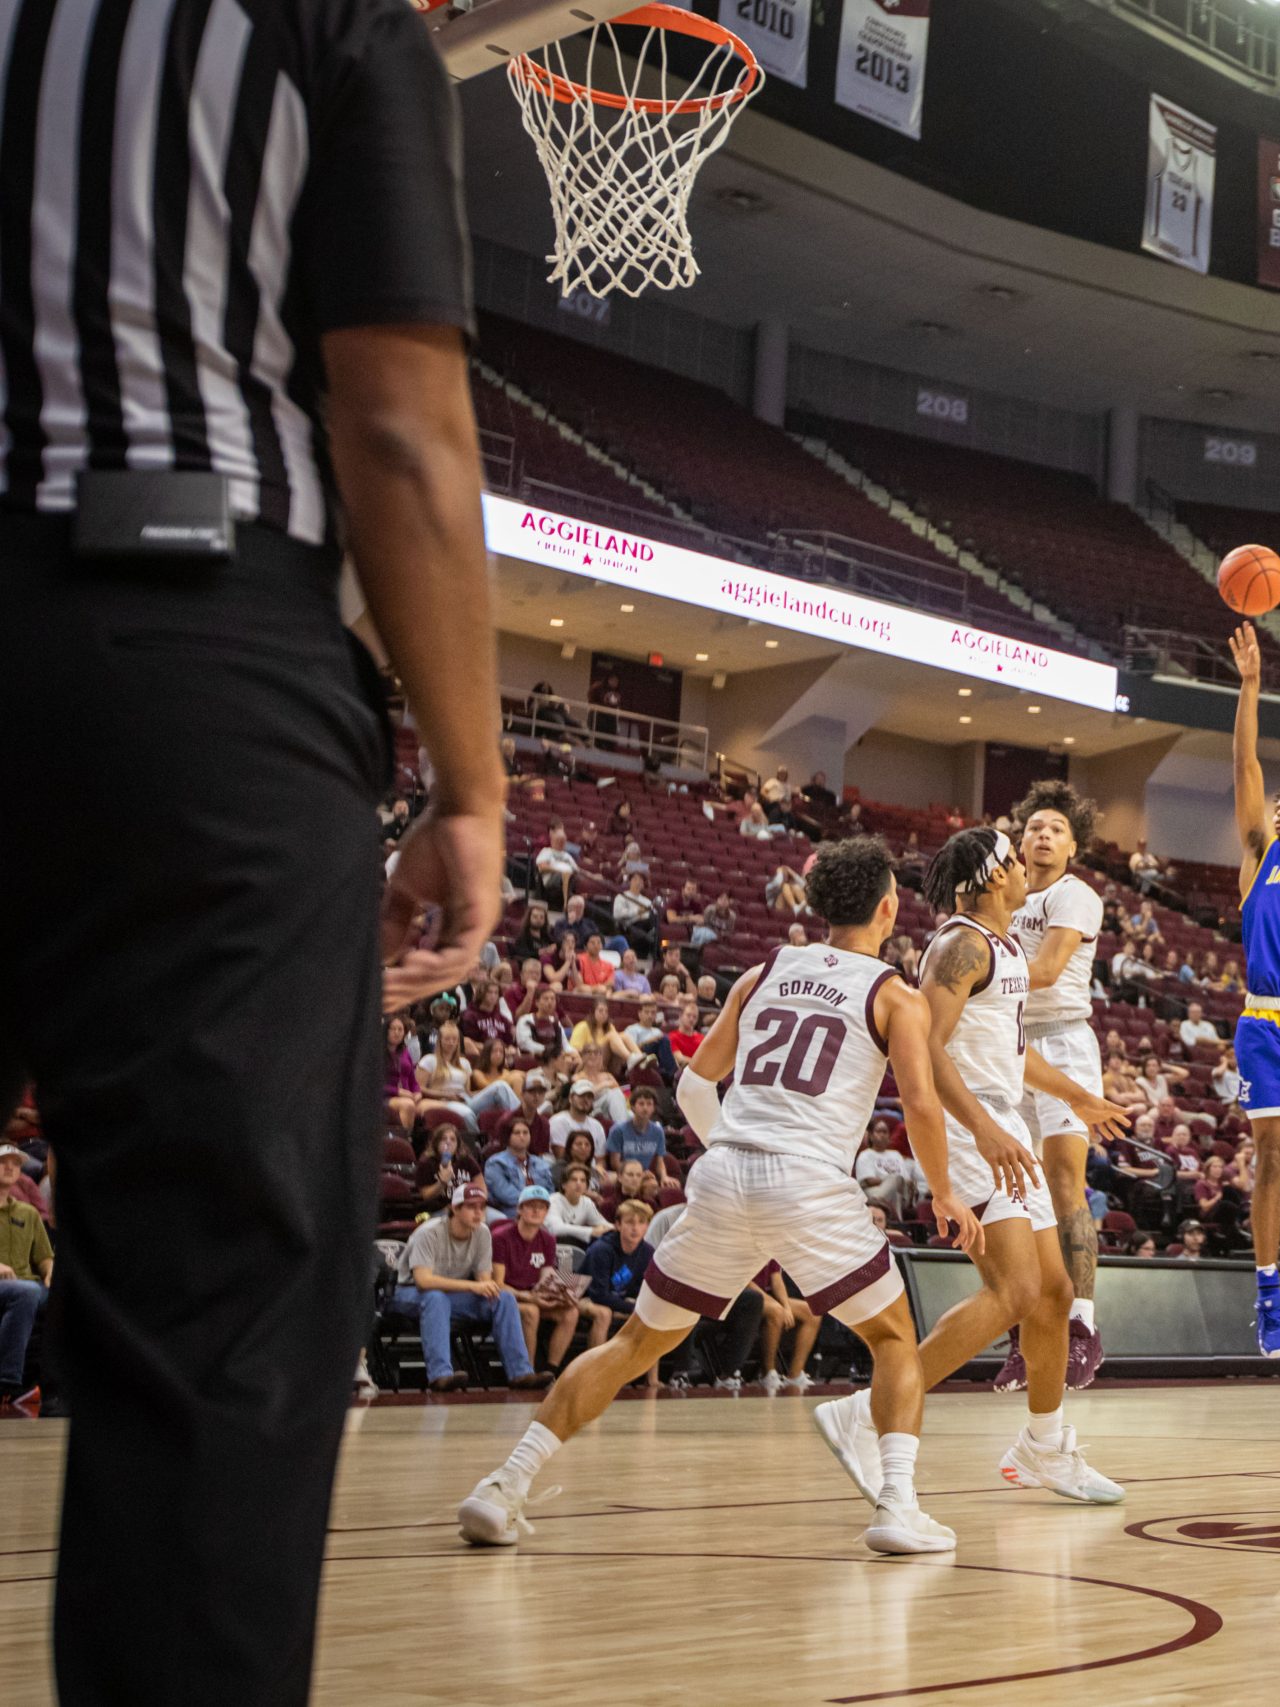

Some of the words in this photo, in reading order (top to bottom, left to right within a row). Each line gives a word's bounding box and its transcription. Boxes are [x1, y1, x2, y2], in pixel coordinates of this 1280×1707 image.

[737, 0, 794, 38] 2010
[855, 46, 909, 93] 2013
[917, 392, 966, 421] 208
[1205, 439, 1255, 465] 209
[521, 512, 654, 562] AGGIELAND
[721, 579, 892, 641] aggielandcu.org
[951, 629, 1048, 668] AGGIELAND
[779, 980, 848, 1007] GORDON
[740, 1007, 848, 1098] 20
